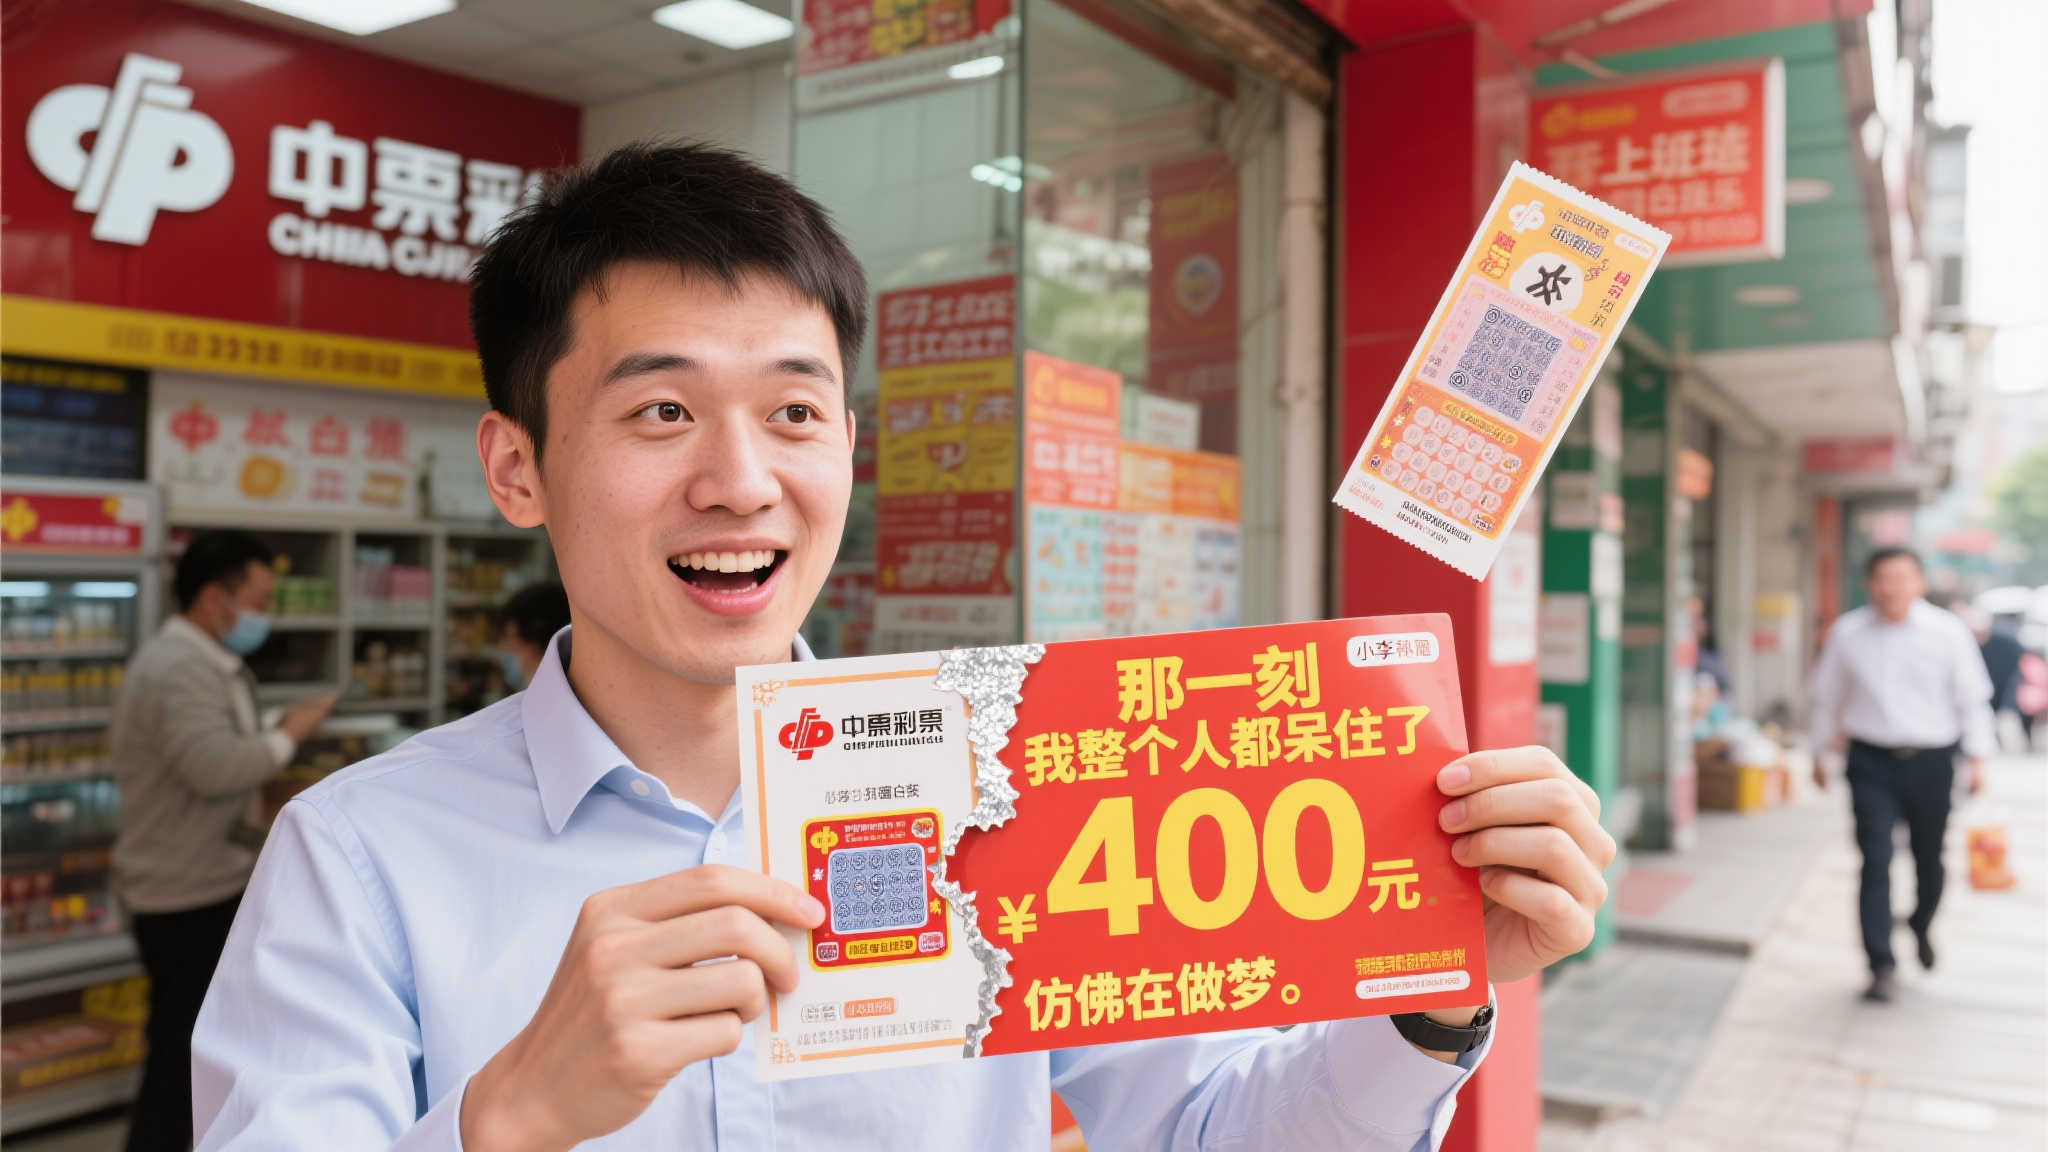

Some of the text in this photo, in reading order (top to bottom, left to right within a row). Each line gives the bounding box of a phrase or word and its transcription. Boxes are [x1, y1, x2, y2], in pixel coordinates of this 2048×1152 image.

[1116, 642, 1321, 723] 那一刻
[1024, 706, 1431, 787] 我整个人都呆住了
[1024, 955, 1301, 1031] 仿佛在做梦。
